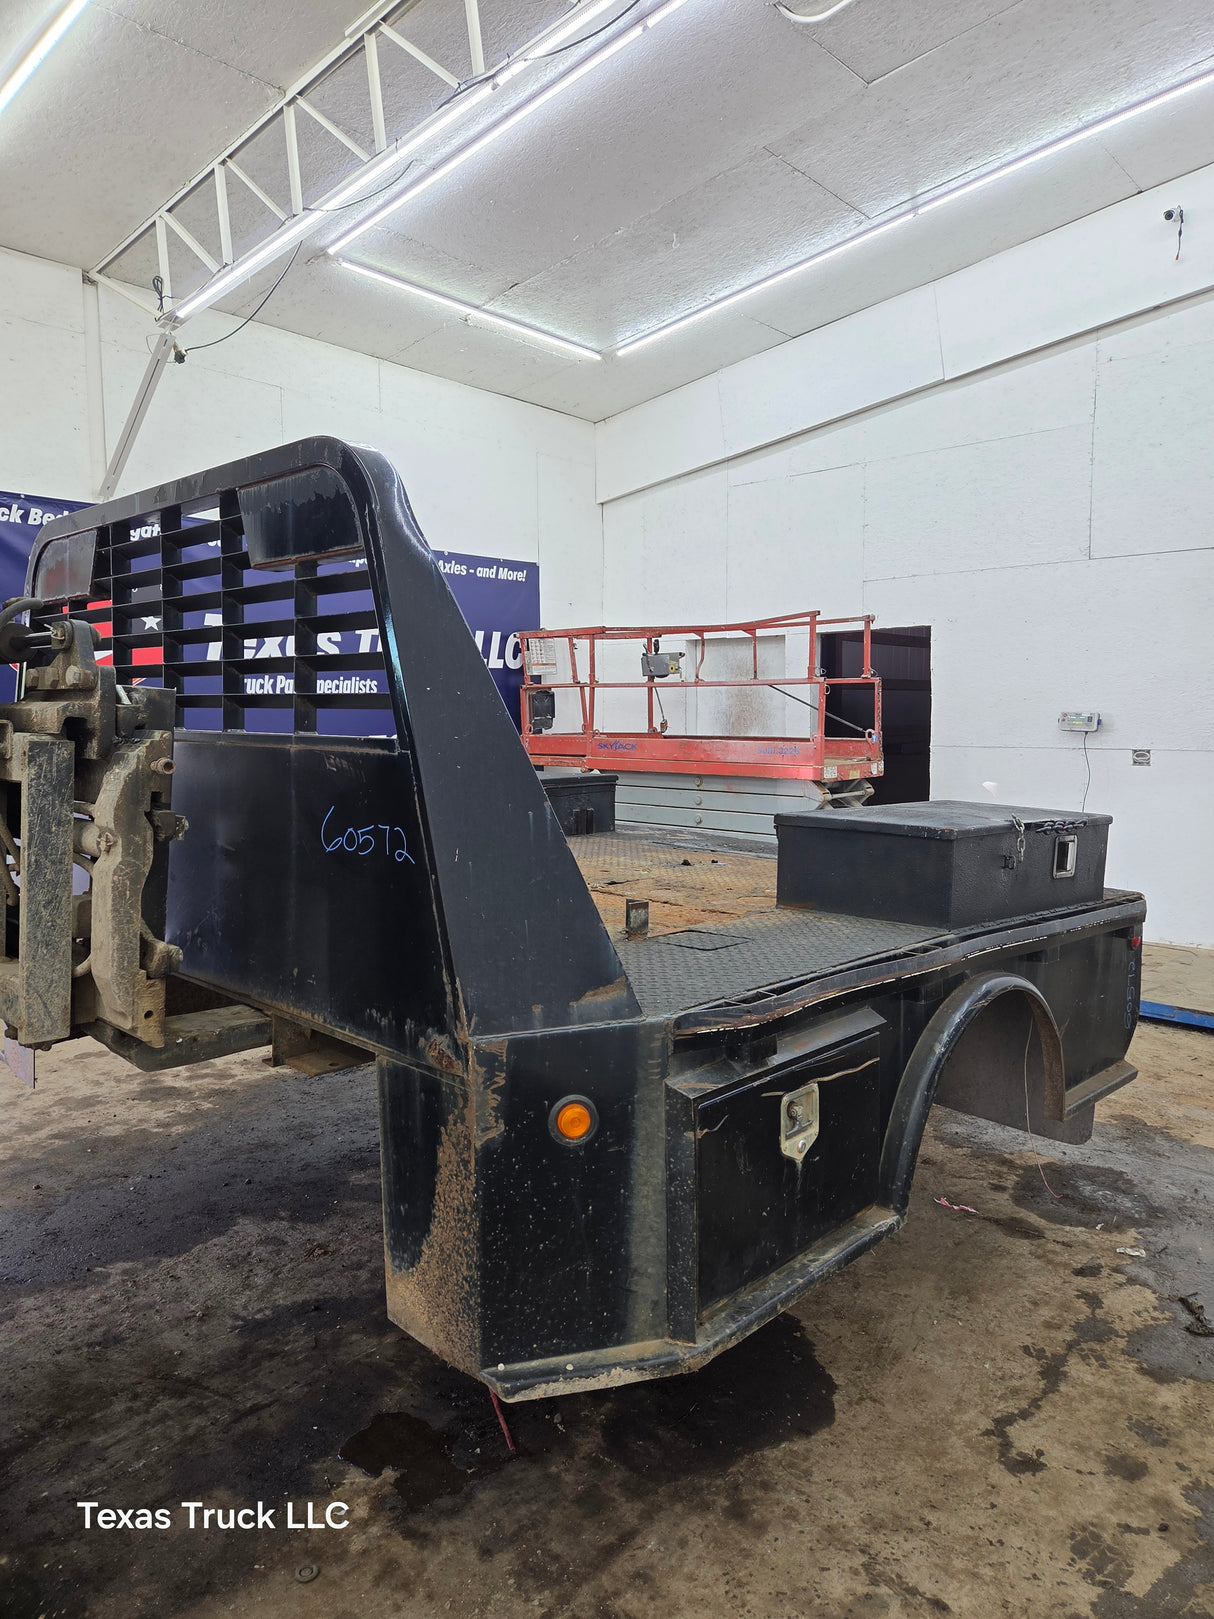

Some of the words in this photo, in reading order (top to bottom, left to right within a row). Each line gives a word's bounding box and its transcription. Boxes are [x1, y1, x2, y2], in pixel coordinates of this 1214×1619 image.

[438, 559, 467, 575] Axles
[476, 565, 497, 578] and
[498, 567, 527, 582] More!
[317, 676, 378, 694] pecialists
[321, 805, 416, 864] 60572
